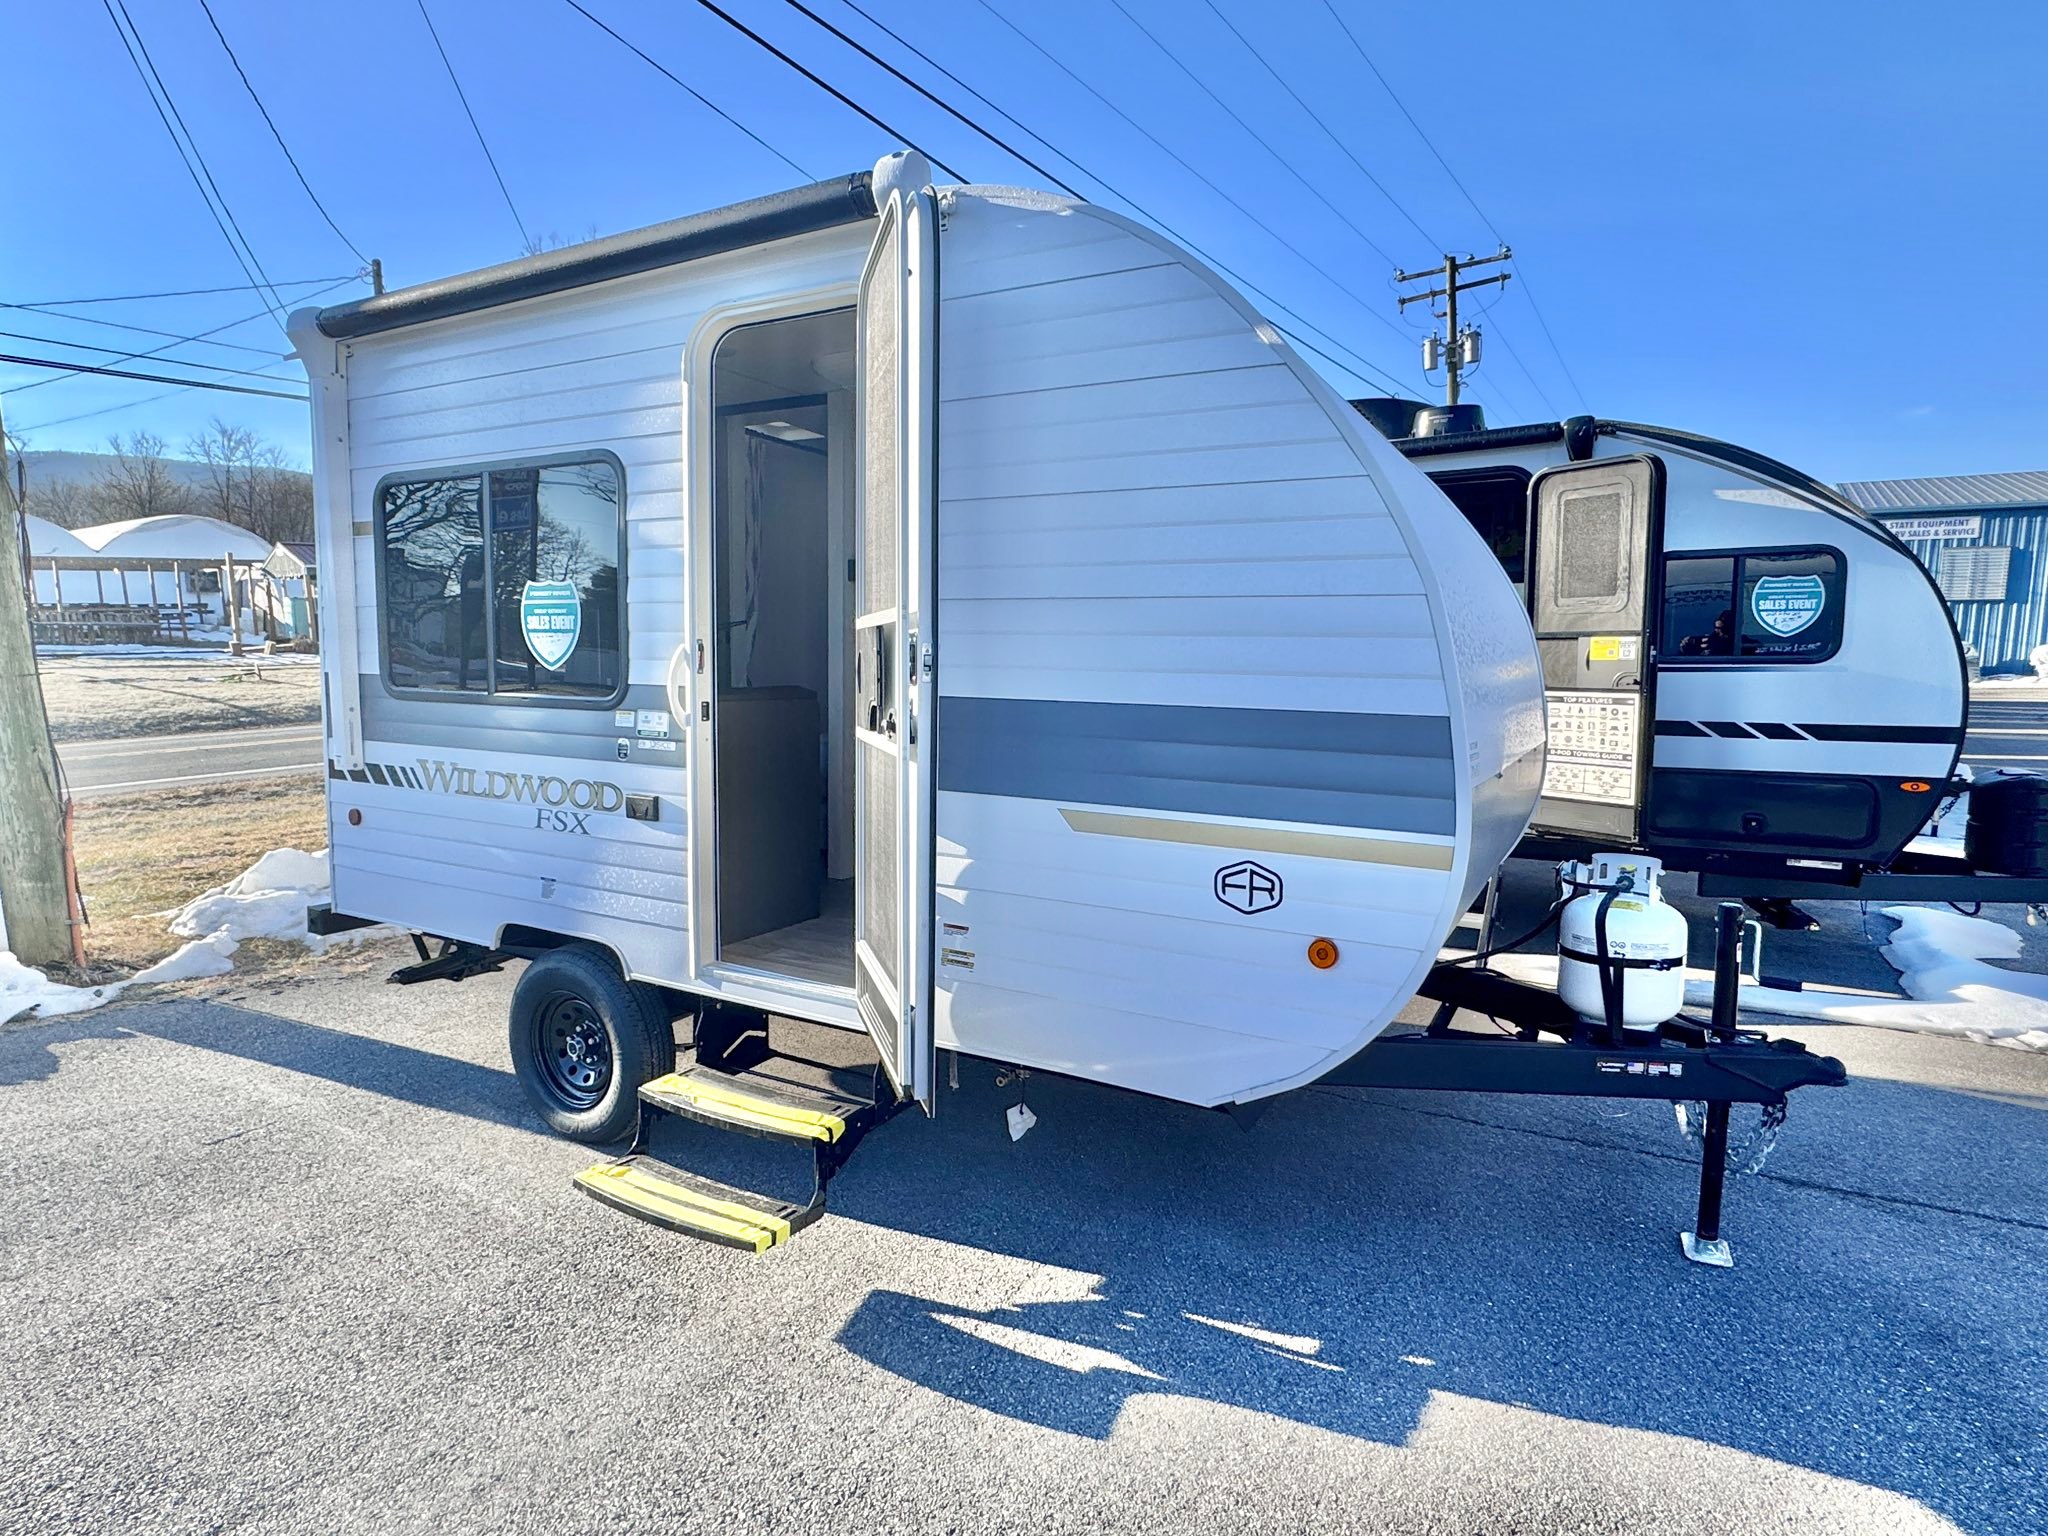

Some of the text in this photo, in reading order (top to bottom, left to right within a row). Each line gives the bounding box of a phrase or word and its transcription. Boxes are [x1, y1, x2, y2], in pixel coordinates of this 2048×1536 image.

[1889, 521, 1915, 530] STATE
[1917, 519, 1970, 529] EQUIPMENT
[1908, 529, 1931, 538] SALES
[1933, 529, 1940, 537] &
[1942, 528, 1977, 536] SERVICE
[1758, 599, 1818, 610] SALES EVENT
[527, 615, 575, 629] SALES EVENT
[416, 758, 624, 812] WILDWOOD
[535, 808, 592, 835] FSX
